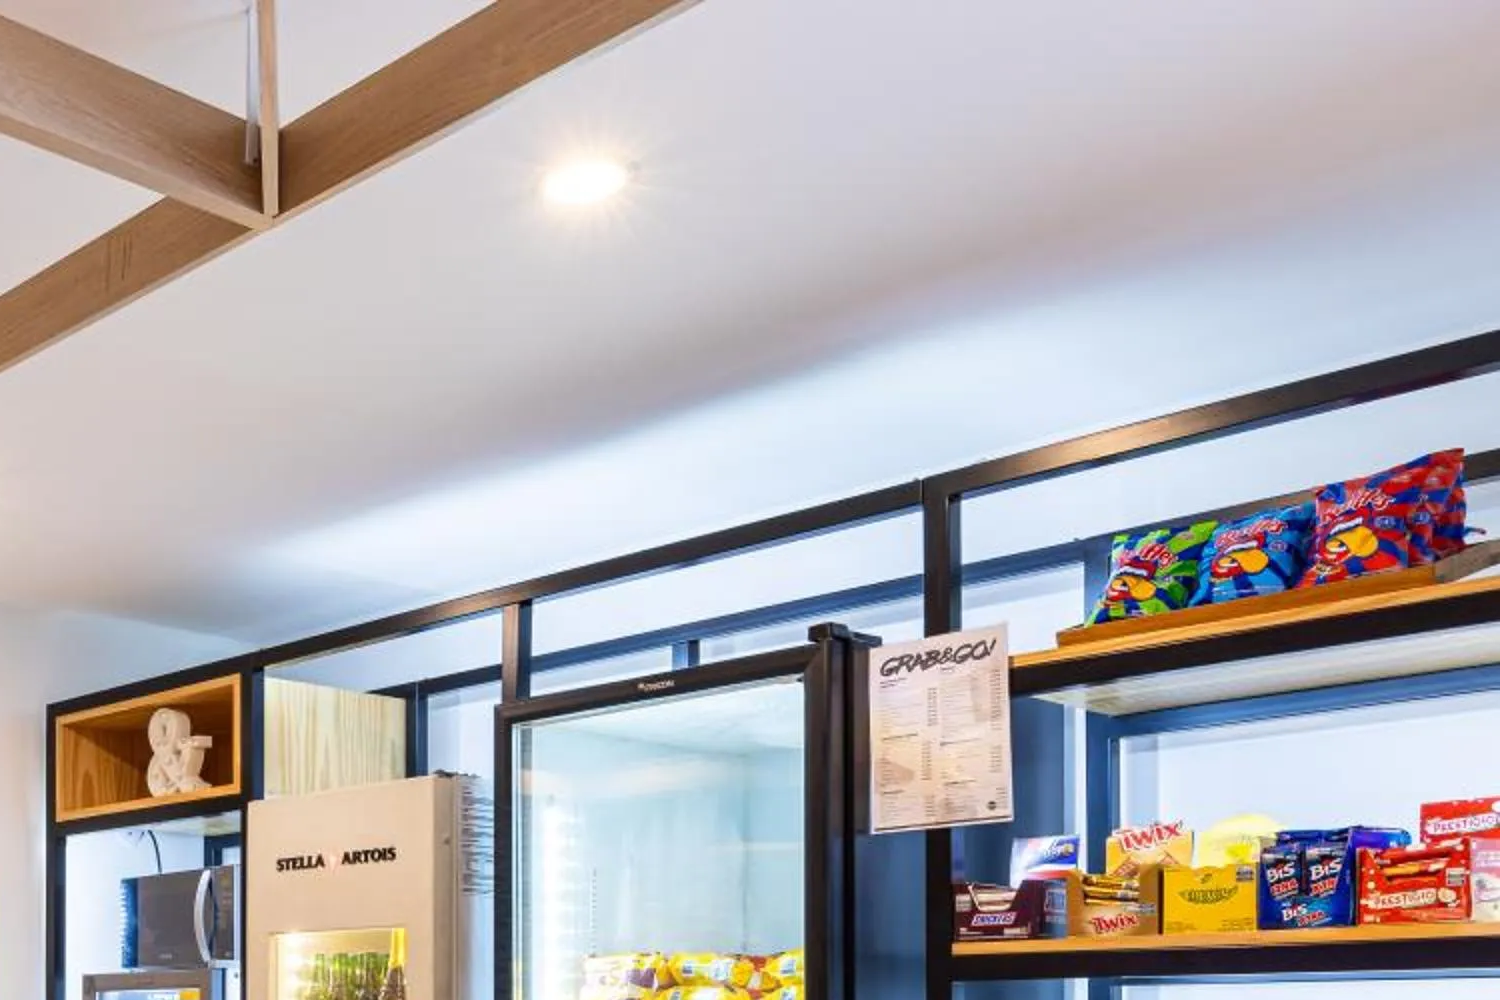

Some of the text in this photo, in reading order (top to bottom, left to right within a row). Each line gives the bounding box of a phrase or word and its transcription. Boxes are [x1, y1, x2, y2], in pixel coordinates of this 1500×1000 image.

[879, 639, 997, 677] GRAB&GO!
[276, 847, 397, 872] STELLA ARTOIS
